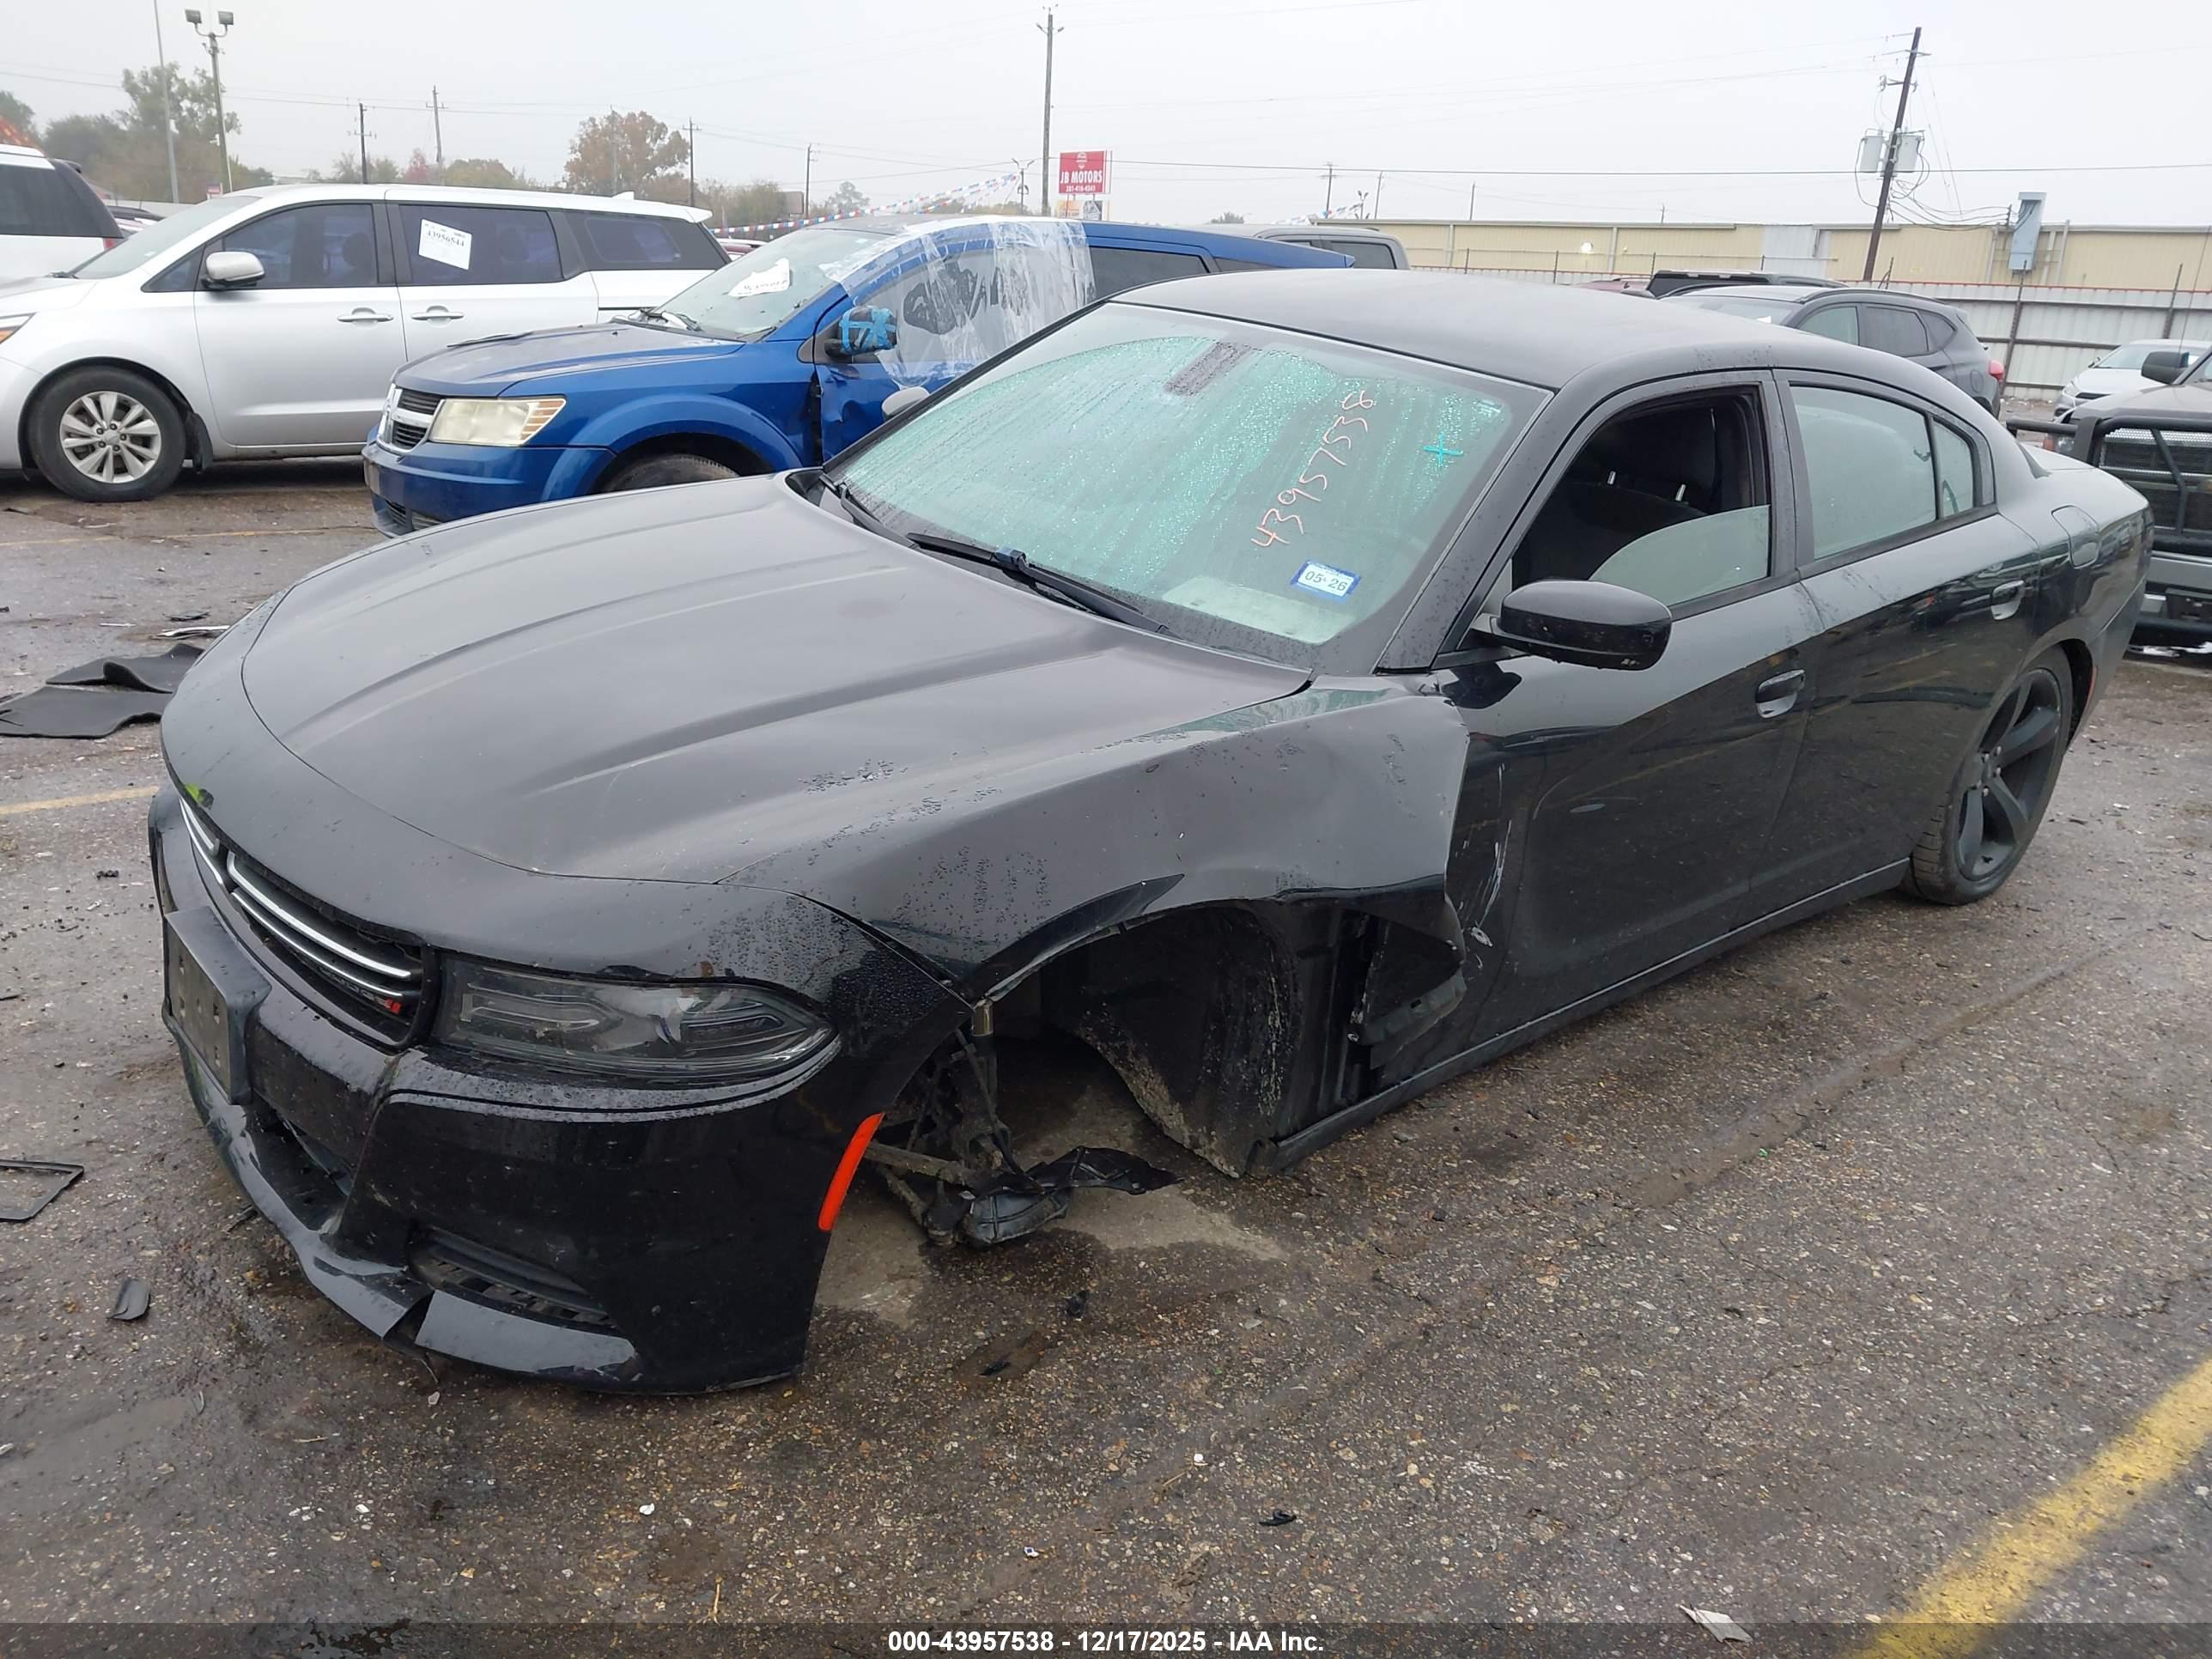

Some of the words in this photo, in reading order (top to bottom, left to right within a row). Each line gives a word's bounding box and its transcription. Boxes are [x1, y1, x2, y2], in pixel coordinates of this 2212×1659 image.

[1060, 172, 1070, 184] JB
[1071, 170, 1103, 184] MOTORS
[1250, 390, 1375, 547] 43957538
[1304, 570, 1324, 583] 05
[1328, 578, 1348, 592] 26
